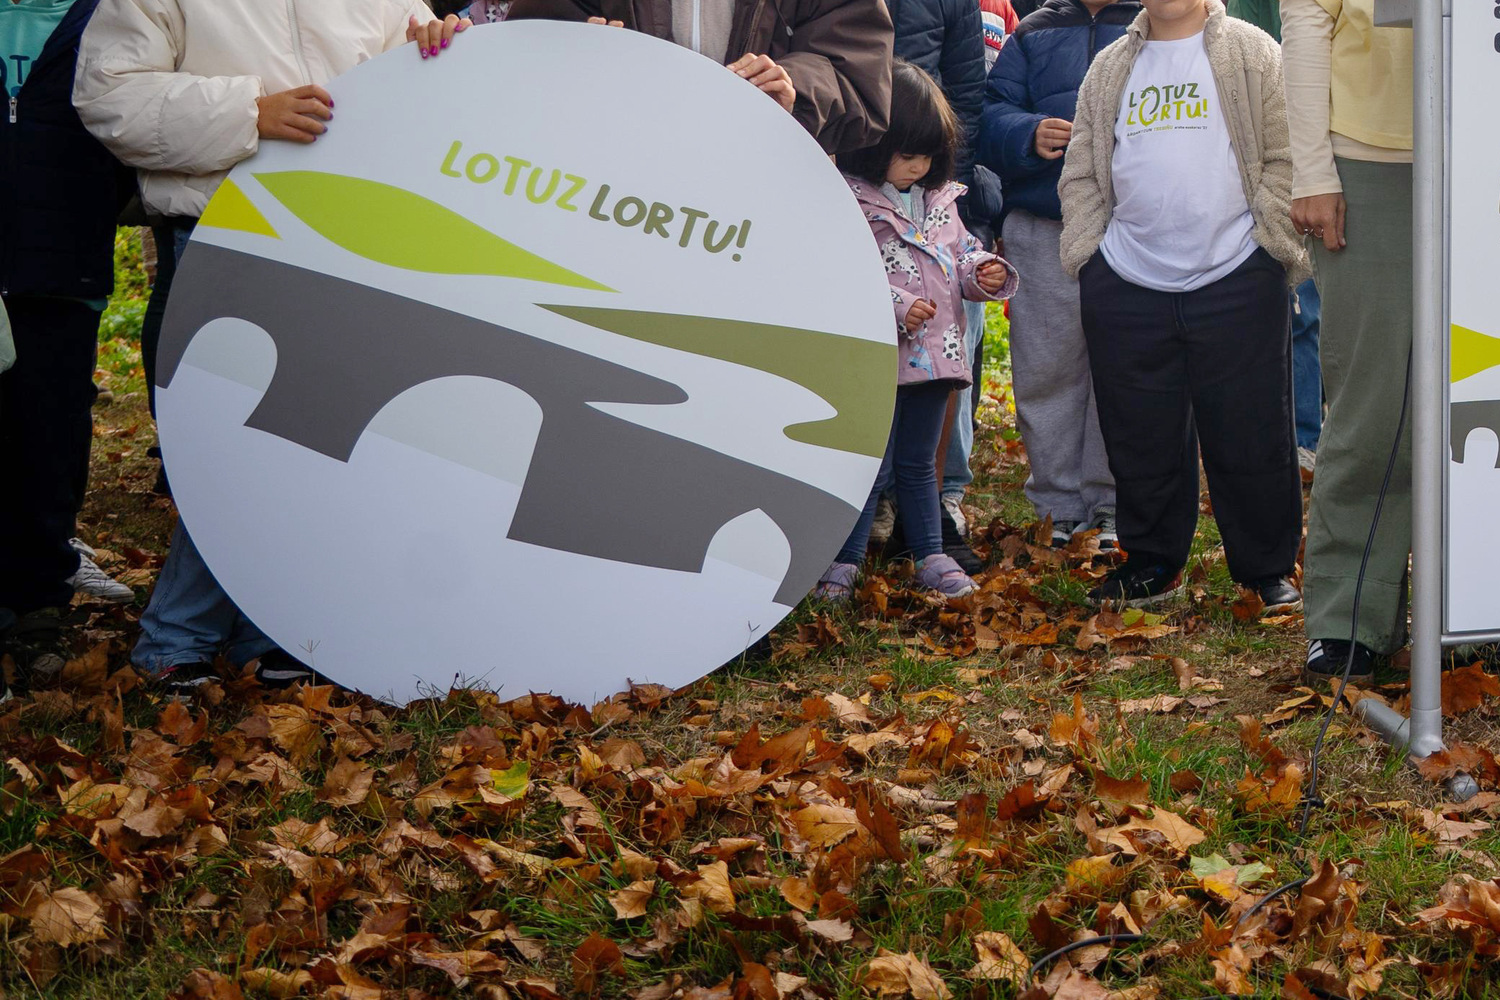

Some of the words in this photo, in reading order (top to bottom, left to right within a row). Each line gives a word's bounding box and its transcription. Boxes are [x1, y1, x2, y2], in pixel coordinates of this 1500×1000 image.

[1126, 98, 1208, 126] LORTU!
[1129, 83, 1200, 114] LOTUZ
[440, 141, 587, 212] LOTUZ
[588, 183, 752, 263] LORTU!
